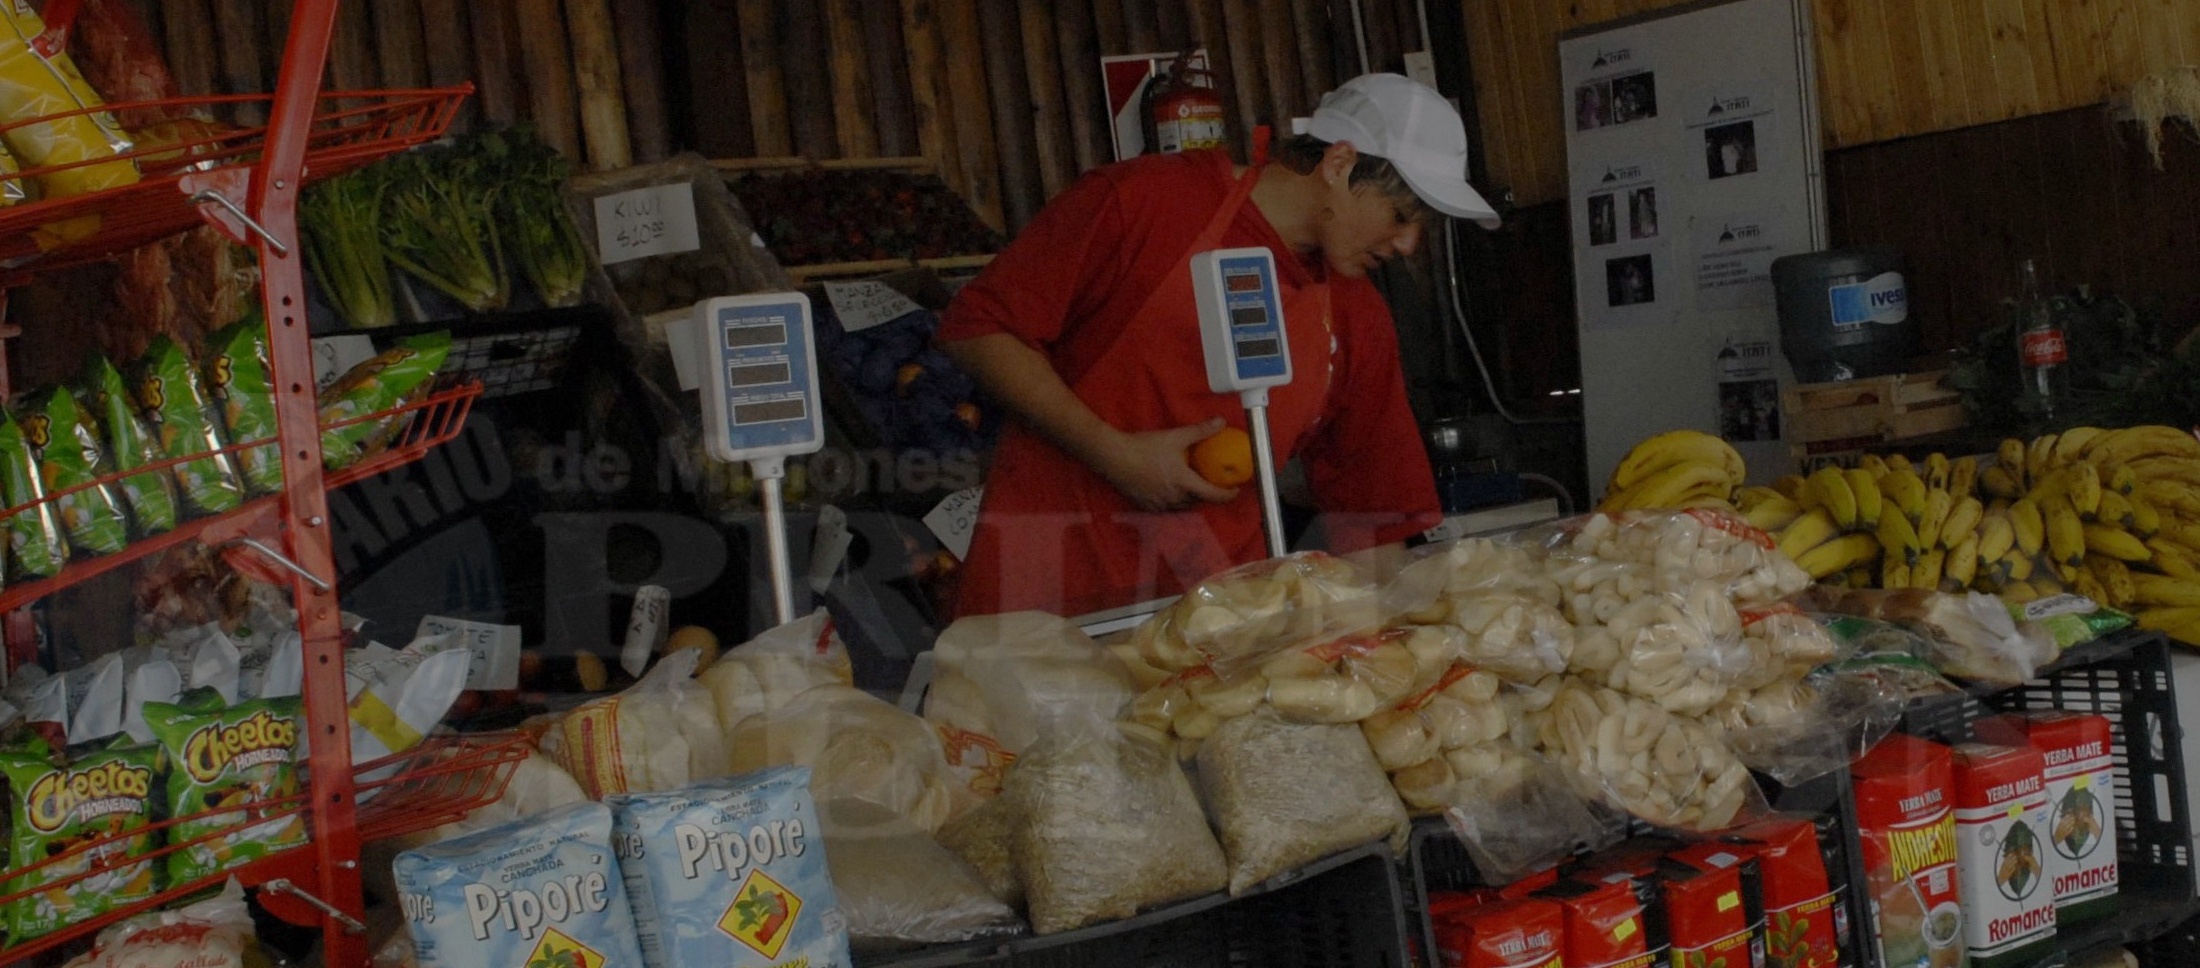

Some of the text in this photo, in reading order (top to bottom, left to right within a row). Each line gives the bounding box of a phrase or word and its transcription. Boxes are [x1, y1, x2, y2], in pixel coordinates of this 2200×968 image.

[185, 709, 296, 784] Cheetos
[2044, 741, 2103, 765] YERBA MATE
[28, 758, 152, 832] Cheetos
[1986, 775, 2040, 803] YERBA MATE
[674, 801, 805, 880] Piporé
[501, 858, 565, 883] CANCHADA
[2052, 863, 2116, 897] omance
[463, 854, 609, 940] Piporé
[1989, 904, 2054, 943] Romance
